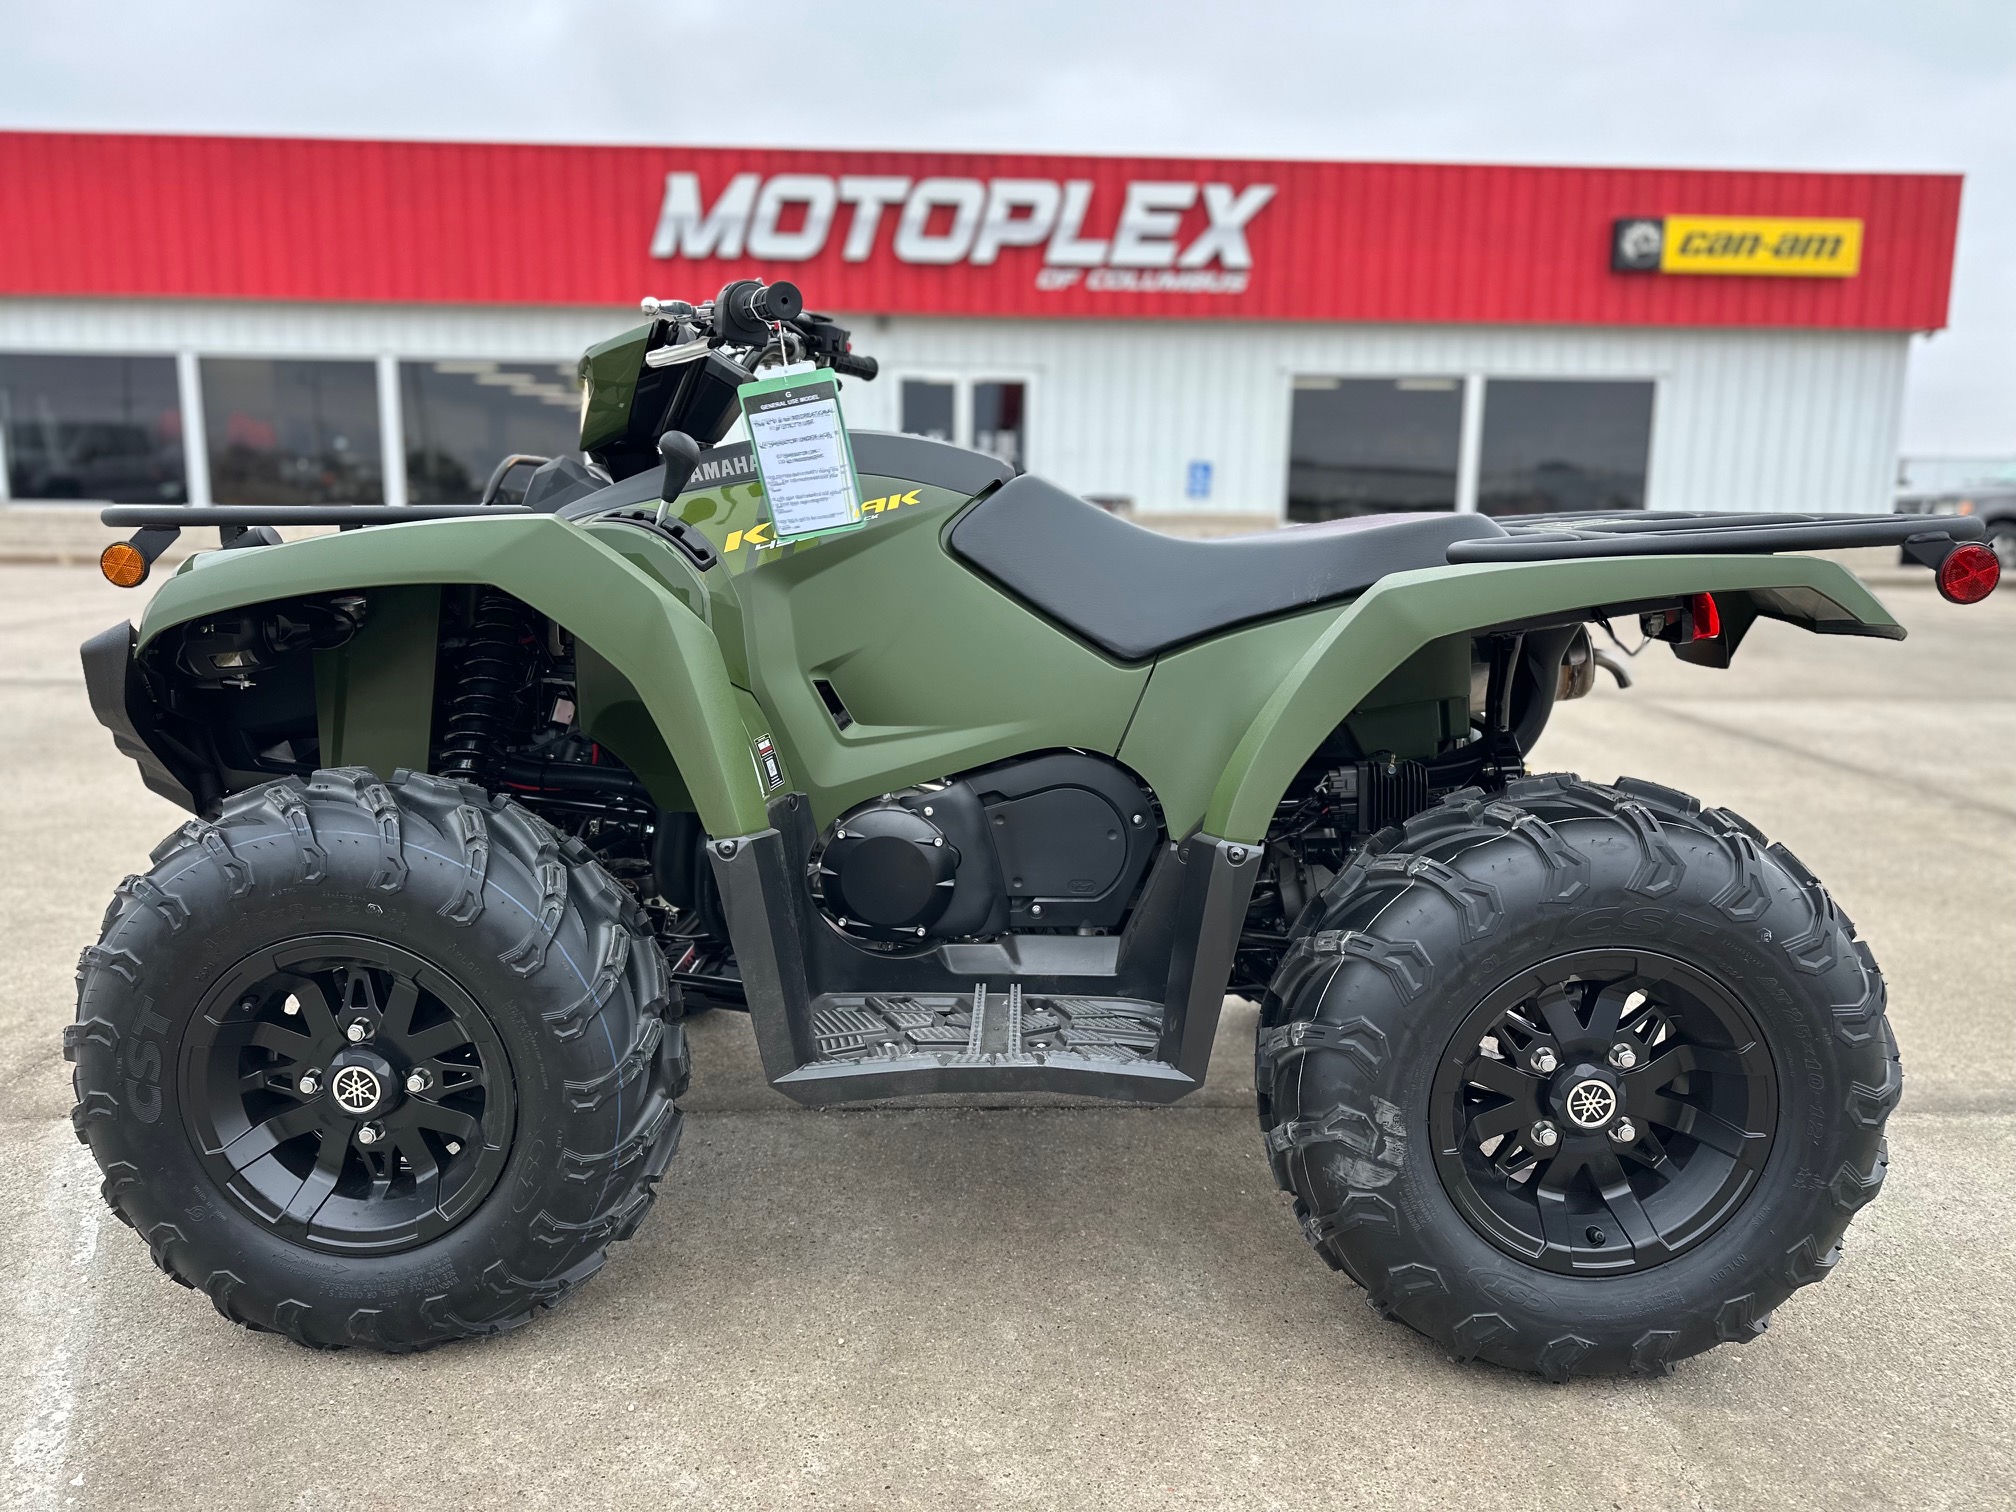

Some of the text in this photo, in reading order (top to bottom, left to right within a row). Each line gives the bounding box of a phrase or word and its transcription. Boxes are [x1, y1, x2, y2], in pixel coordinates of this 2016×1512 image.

[650, 171, 1277, 269] MOTOPLEX
[1679, 230, 1844, 259] can-am
[1035, 267, 1251, 294] OF COLUMBUS
[760, 400, 787, 411] GENERAL
[799, 394, 820, 403] MODEL
[690, 454, 758, 483] AMAHA
[1566, 905, 1720, 946] CST
[125, 994, 173, 1124] CST
[1709, 1253, 1748, 1284] NYLON
[424, 1276, 460, 1297] WARNING
